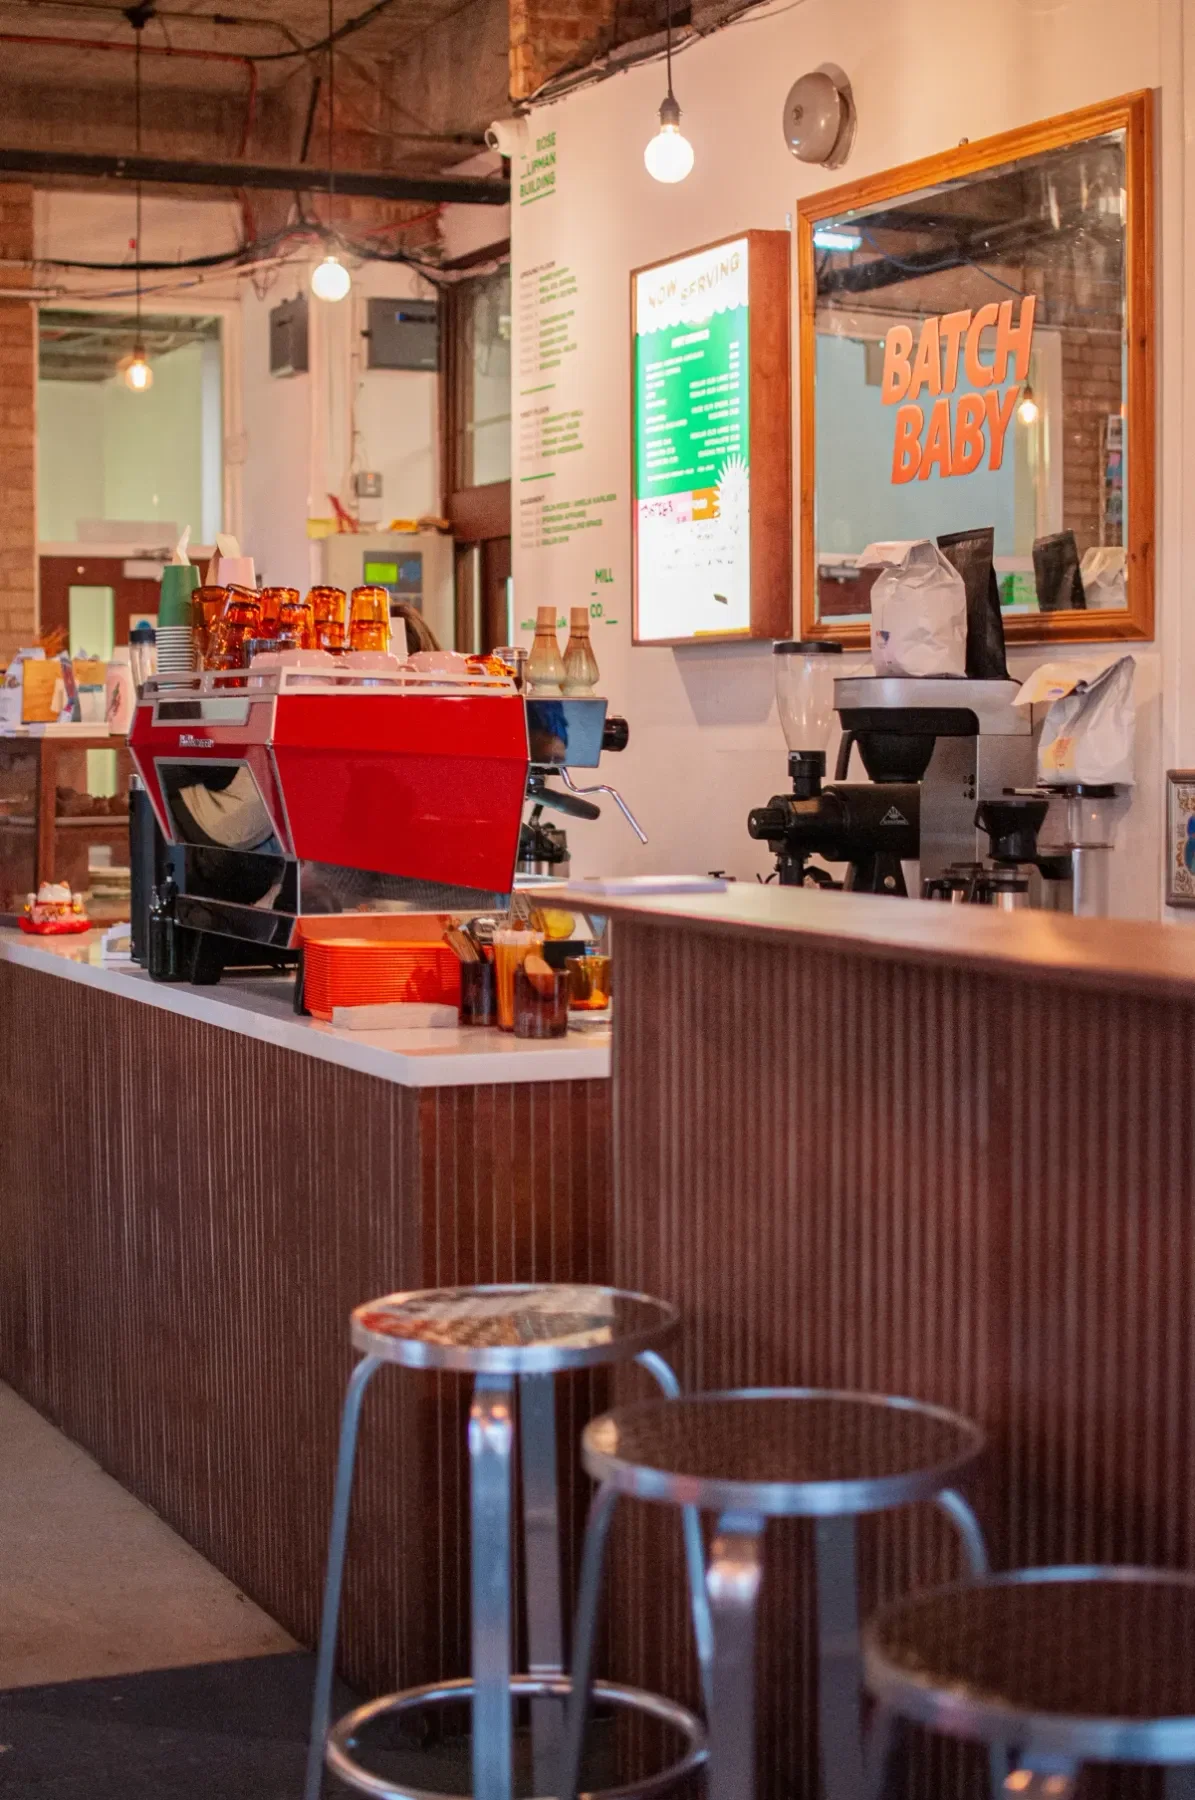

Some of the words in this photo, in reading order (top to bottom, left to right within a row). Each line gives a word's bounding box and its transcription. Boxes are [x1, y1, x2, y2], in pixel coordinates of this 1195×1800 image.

[520, 171, 556, 197] BUILDING
[648, 276, 677, 308] NOW
[681, 251, 740, 306] SERVING
[881, 295, 1037, 406] BATCH
[891, 385, 1020, 485] BABY
[595, 568, 614, 584] MILL
